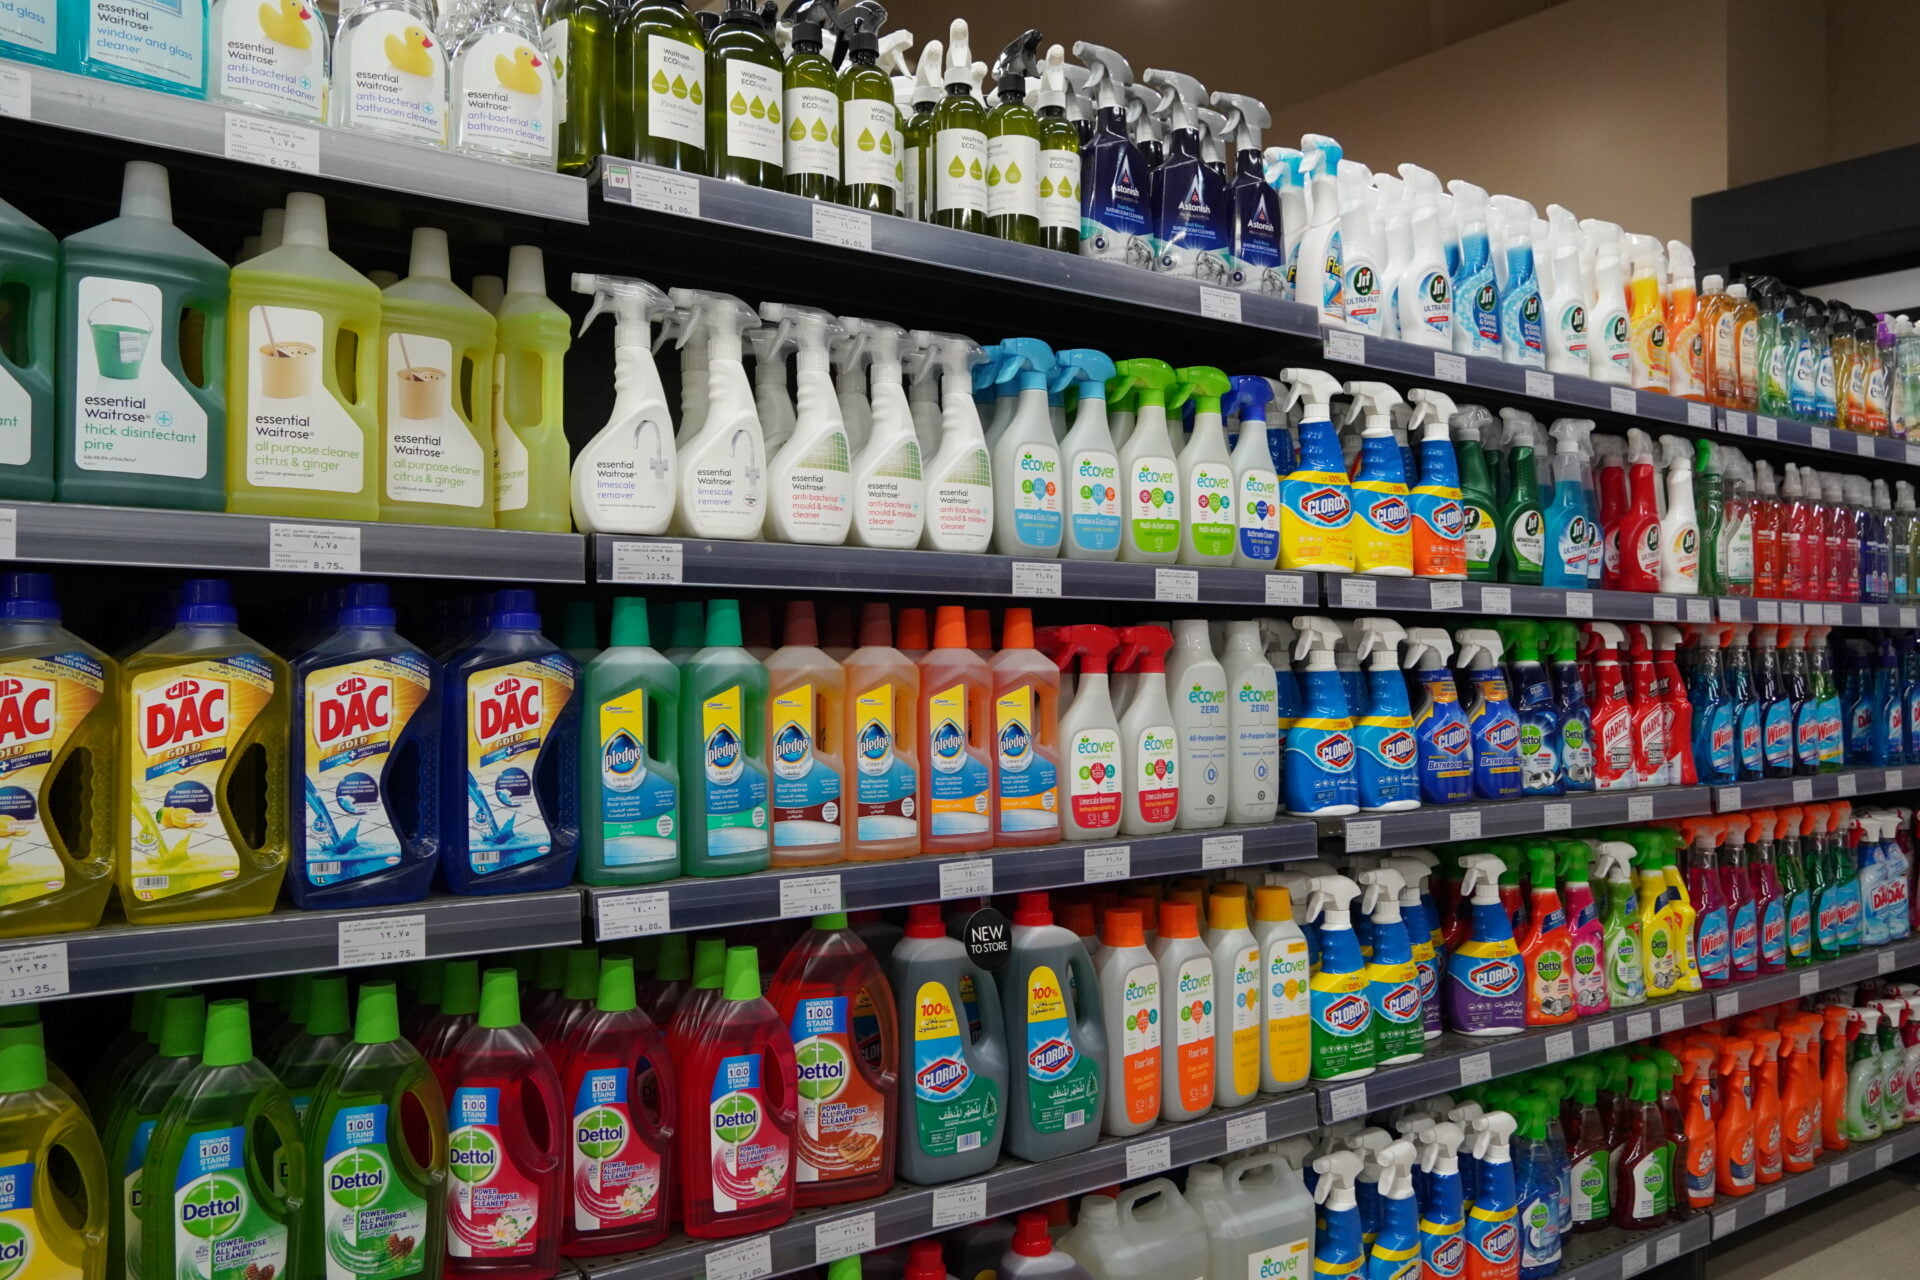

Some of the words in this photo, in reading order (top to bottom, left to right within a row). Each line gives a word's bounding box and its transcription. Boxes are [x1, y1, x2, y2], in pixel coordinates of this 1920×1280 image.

[97, 26, 142, 44] window
[145, 37, 167, 52] and
[169, 43, 193, 61] glass
[97, 38, 140, 55] cleaner
[227, 51, 274, 66] Waitrose
[356, 70, 399, 84] essential
[227, 74, 280, 92] bathroom
[281, 85, 316, 102] cleaner
[356, 91, 420, 111] anti-bacterial
[356, 102, 404, 118] bathroom
[406, 110, 438, 127] cleaner
[467, 110, 529, 128] anti-bacterial
[467, 120, 514, 136] bathroom
[515, 128, 546, 143] cleaner
[1178, 201, 1211, 215] Astonish
[1247, 219, 1274, 232] Astonish
[85, 394, 146, 410] essential
[84, 423, 118, 437] thick
[121, 428, 197, 444] disinfectant
[84, 438, 114, 453] pine
[255, 441, 269, 452] all
[270, 442, 319, 458] purpose
[321, 447, 360, 460] cleaner
[255, 455, 289, 467] citrus
[291, 456, 300, 467] &
[302, 458, 340, 472] ginger
[394, 459, 407, 468] all
[408, 460, 449, 474] purpose
[450, 464, 481, 477] cleaner
[597, 460, 634, 470] essential
[1021, 458, 1056, 473] ecover
[597, 470, 634, 479] Waitrose
[697, 468, 732, 477] essential
[792, 474, 823, 483] essential
[1080, 464, 1115, 479] ecover
[1139, 470, 1173, 483] ecover
[394, 472, 424, 482] citrus
[425, 474, 433, 483] &
[435, 475, 466, 488] ginger
[597, 480, 636, 490] limescale
[697, 477, 732, 486] Waitrose
[868, 482, 898, 491] essential
[1197, 476, 1229, 489] ecover
[597, 491, 634, 500] remover
[697, 488, 733, 497] limescale
[792, 493, 838, 503] anti-bacterial
[698, 498, 731, 506] remover
[793, 502, 817, 511] mould
[868, 499, 911, 510] anti-bacterial
[1307, 495, 1347, 516] CLOROX
[793, 511, 820, 519] cleaner
[868, 517, 895, 525] cleaner
[940, 522, 965, 530] cleaner
[54, 655, 103, 678] MULTI-PURPOSE
[228, 657, 272, 680] MULTI-PURPOSE
[1189, 689, 1227, 704] ecover
[320, 685, 388, 743] DAC
[480, 685, 539, 740] DAC
[1200, 705, 1220, 714] ZERO
[1250, 704, 1270, 713] ZERO
[146, 688, 225, 750] DAC
[1642, 714, 1663, 738] HARPIC
[1565, 729, 1583, 740] Dettol
[1605, 716, 1627, 743] HARPIC
[337, 736, 369, 752] GOLD
[496, 733, 523, 749] GOLD
[859, 734, 889, 758] pledge
[934, 734, 964, 757] pledge
[1000, 734, 1029, 756] pledge
[1078, 739, 1115, 755] ecover
[168, 741, 202, 759] GOLD
[708, 741, 740, 767] pledge
[776, 737, 809, 761] pledge
[1323, 739, 1352, 762] CLOROX
[605, 746, 641, 772] pledge
[1428, 761, 1463, 771] BATHROOM
[971, 924, 1004, 943] NEW
[380, 949, 412, 960] 12.75
[970, 944, 983, 954] TO
[983, 940, 1008, 953] STORE
[1617, 946, 1634, 955] Dettol
[1537, 960, 1561, 972] Dettol
[1476, 965, 1516, 987] CLOROX
[10, 984, 50, 998] 13.25
[1032, 985, 1058, 1000] 100%
[921, 1002, 951, 1017] 100%
[1389, 992, 1419, 1014] CLOROX
[807, 1006, 834, 1019] 100
[1331, 1000, 1365, 1027] CLOROX
[806, 1019, 834, 1028] STAINS
[1034, 1041, 1071, 1068] CLOROX
[1188, 1047, 1199, 1059] Floor
[728, 1076, 750, 1085] STAINS
[821, 1103, 846, 1112] POWER
[821, 1110, 834, 1119] ALL
[836, 1106, 867, 1117] PURPOSE
[346, 1112, 374, 1121] REMOVES
[715, 1110, 757, 1129] Dettol
[821, 1116, 854, 1126] CLEANER
[200, 1136, 231, 1145] REMOVES
[346, 1131, 374, 1140] STAINS
[740, 1144, 760, 1153] POWER
[200, 1155, 231, 1166] STAINS
[739, 1155, 765, 1164] CLEANER
[331, 1170, 383, 1191] Dettol
[604, 1172, 632, 1181] CLEANER
[1644, 1173, 1663, 1186] Dettol
[183, 1196, 241, 1221] Dettol
[360, 1210, 386, 1219] POWER
[360, 1217, 373, 1226] ALL
[376, 1211, 407, 1223] PURPOSE
[1530, 1212, 1548, 1222] Dettol
[360, 1221, 393, 1232] CLEANER
[216, 1238, 244, 1249] POWER
[1487, 1228, 1515, 1251] CLOROX
[216, 1248, 229, 1257] ALL
[232, 1239, 267, 1252] PURPOSE
[216, 1250, 252, 1263] CLEANER
[1260, 1255, 1299, 1279] ecover
